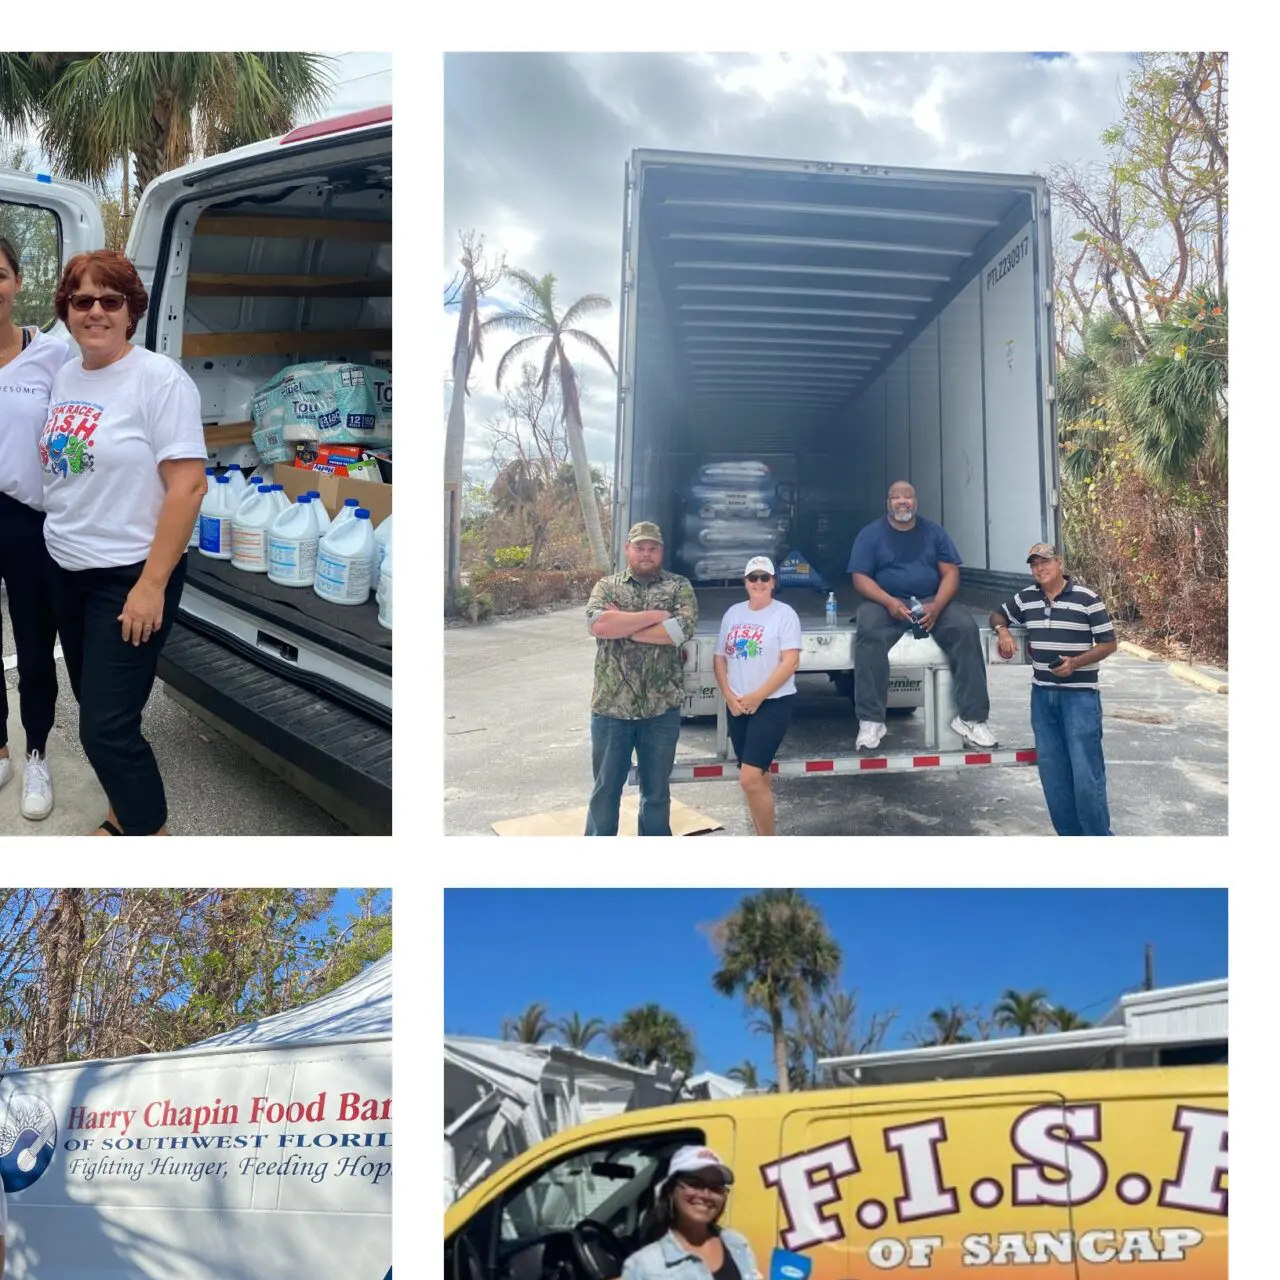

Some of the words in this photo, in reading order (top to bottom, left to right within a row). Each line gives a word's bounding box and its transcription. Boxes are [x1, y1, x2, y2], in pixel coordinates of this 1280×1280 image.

[67, 1106, 136, 1136] Harry
[144, 1098, 239, 1133] Chapin
[248, 1092, 326, 1124] Food
[64, 1139, 95, 1151] OF
[102, 1134, 268, 1151] SOUTHWEST
[70, 1156, 143, 1182] Fighting
[147, 1156, 228, 1180] Hunger,
[239, 1154, 328, 1184] Feeding
[333, 1155, 392, 1185] Hop
[867, 1235, 943, 1270] OF
[961, 1227, 1205, 1267] SANCAP
